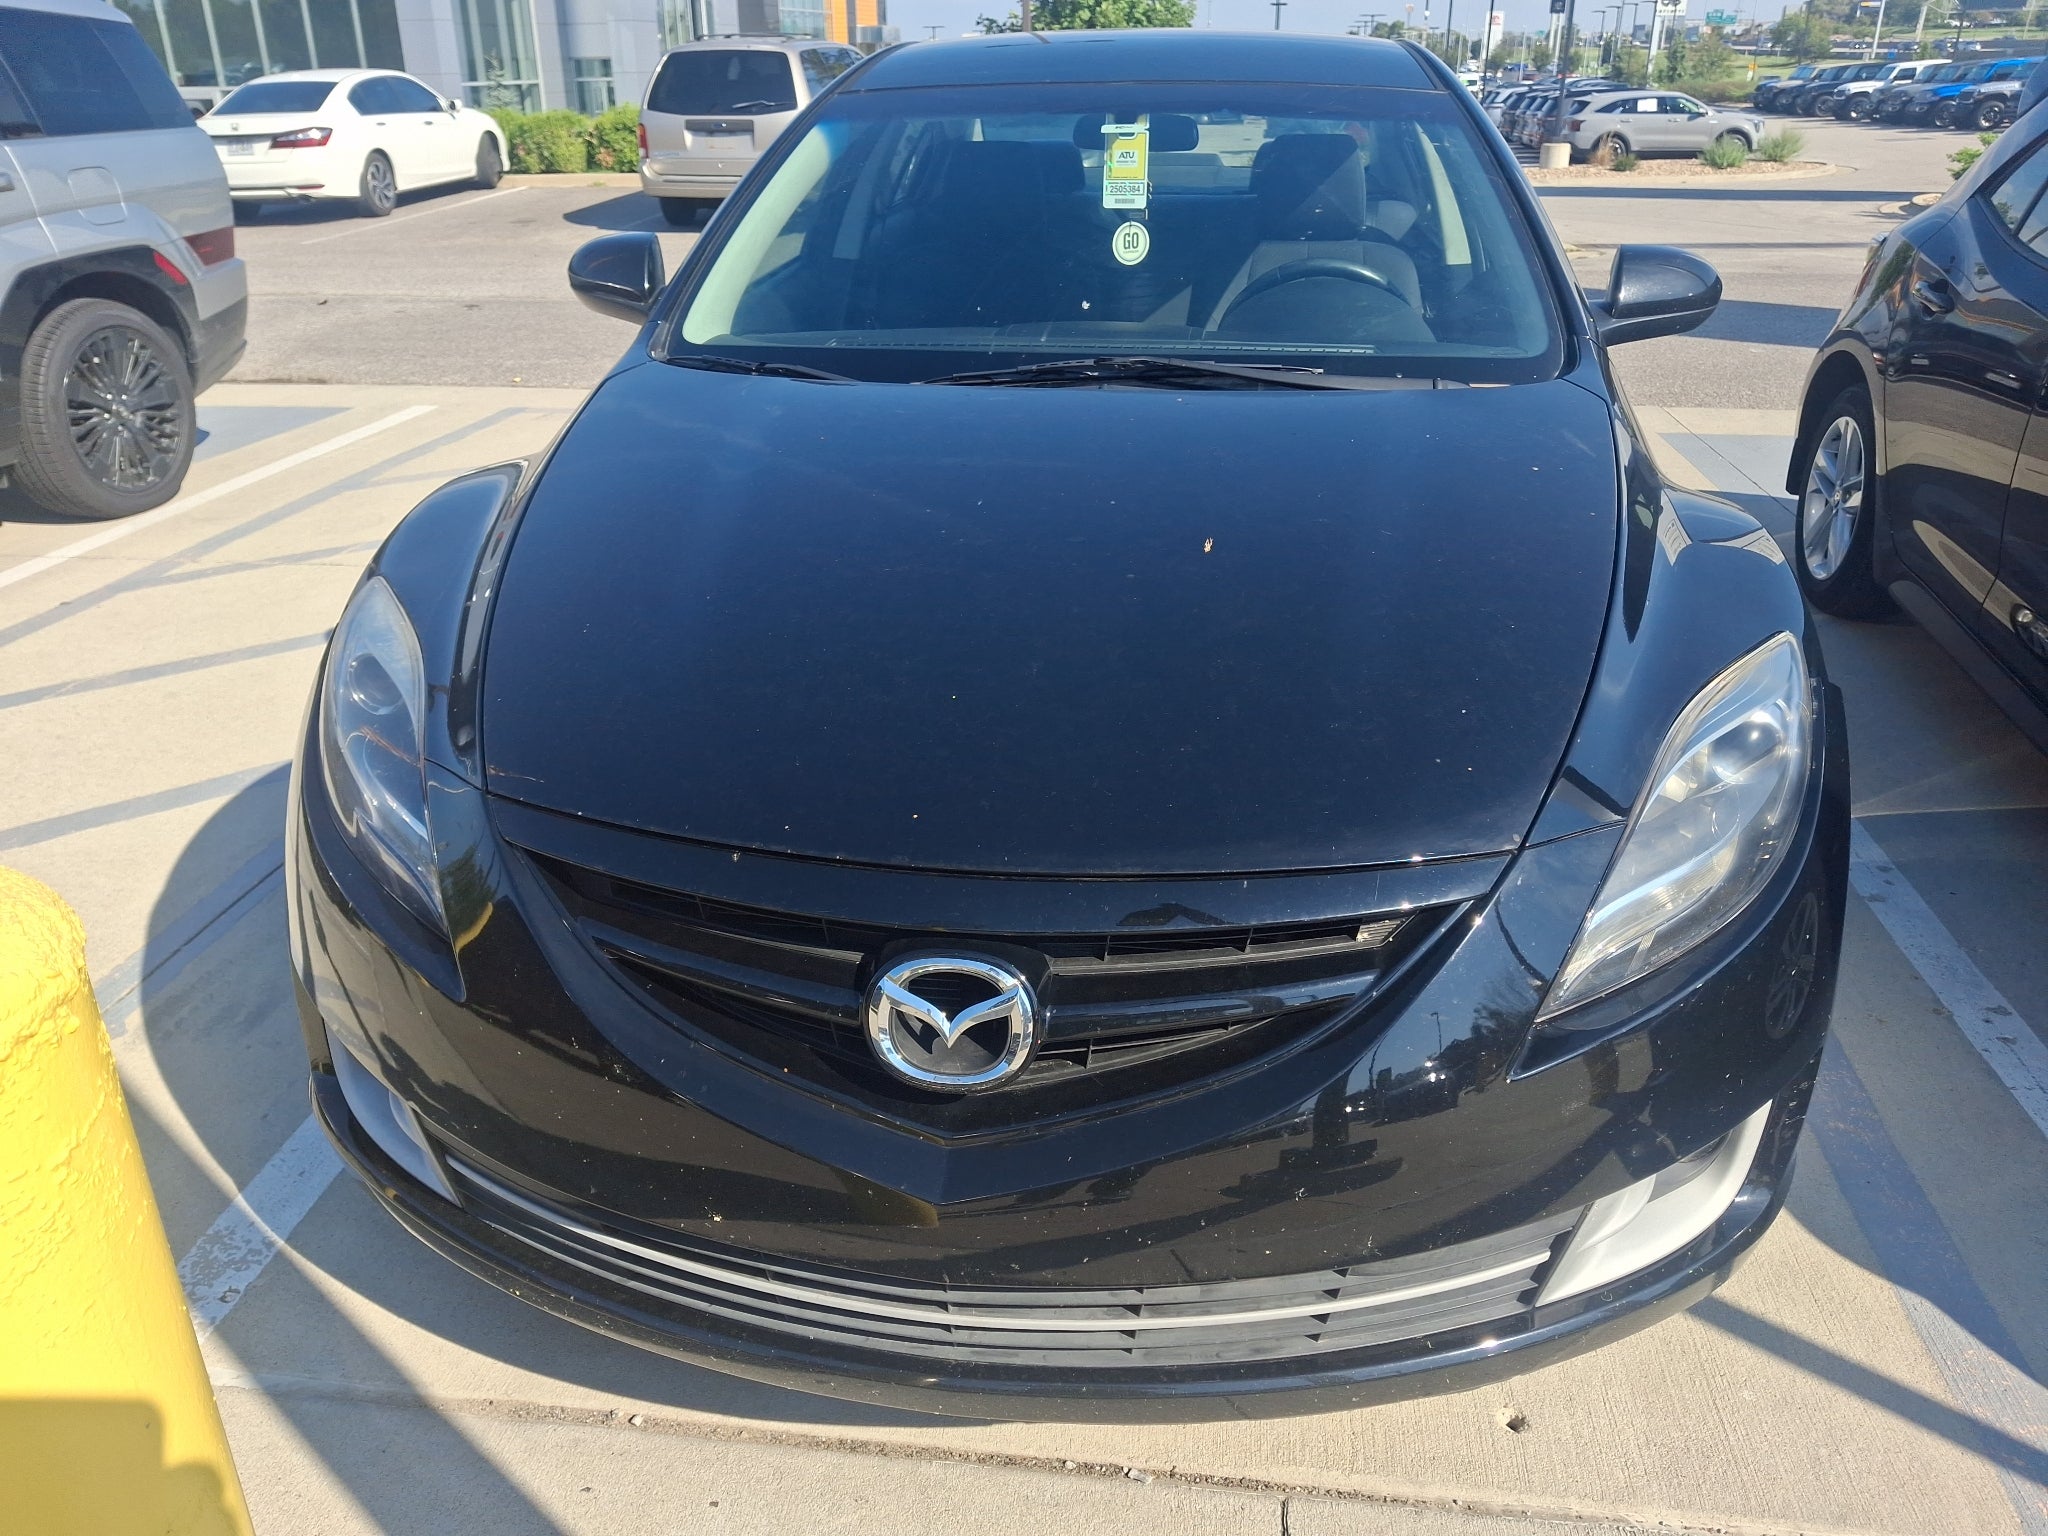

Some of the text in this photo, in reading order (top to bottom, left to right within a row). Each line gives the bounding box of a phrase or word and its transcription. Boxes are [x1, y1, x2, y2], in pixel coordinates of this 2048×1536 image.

[1118, 151, 1135, 159] ATU
[1109, 184, 1141, 193] 2505384
[1123, 232, 1139, 250] GO
